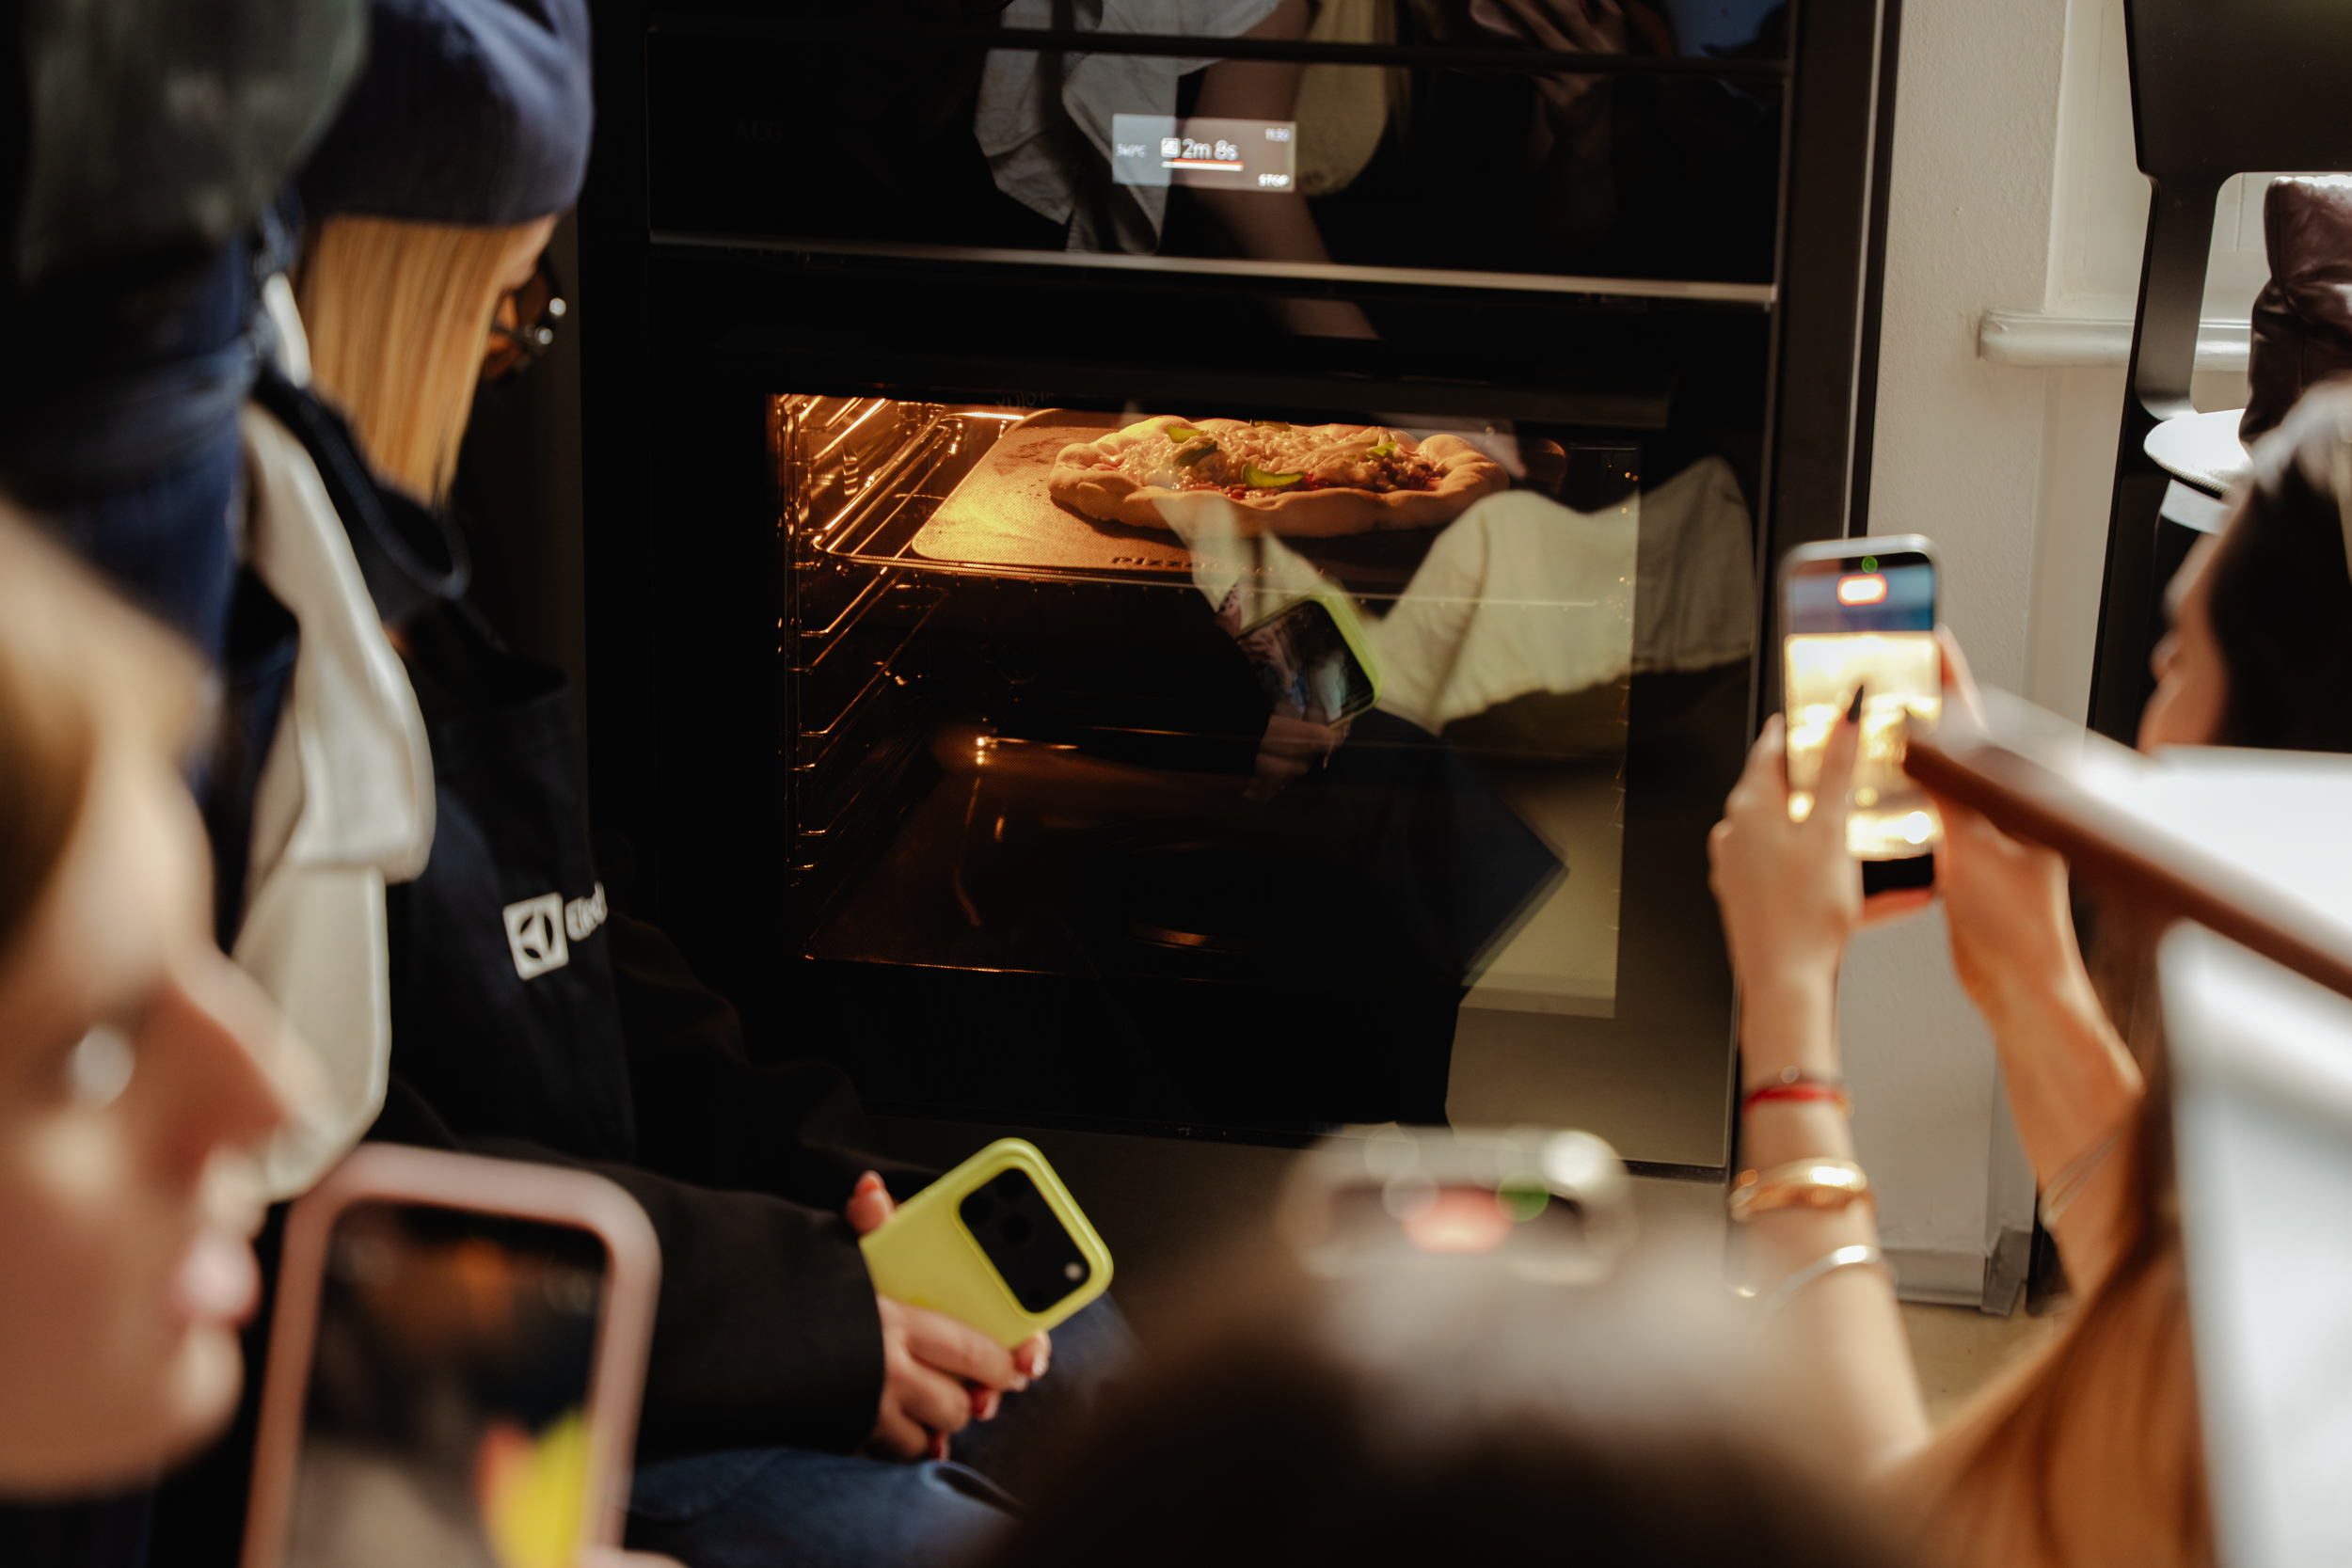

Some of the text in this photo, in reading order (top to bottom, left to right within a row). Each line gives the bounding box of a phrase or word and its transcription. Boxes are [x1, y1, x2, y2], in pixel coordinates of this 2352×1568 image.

[733, 119, 784, 141] AEG
[1181, 137, 1239, 161] 2m 8s
[1257, 173, 1290, 187] STOP
